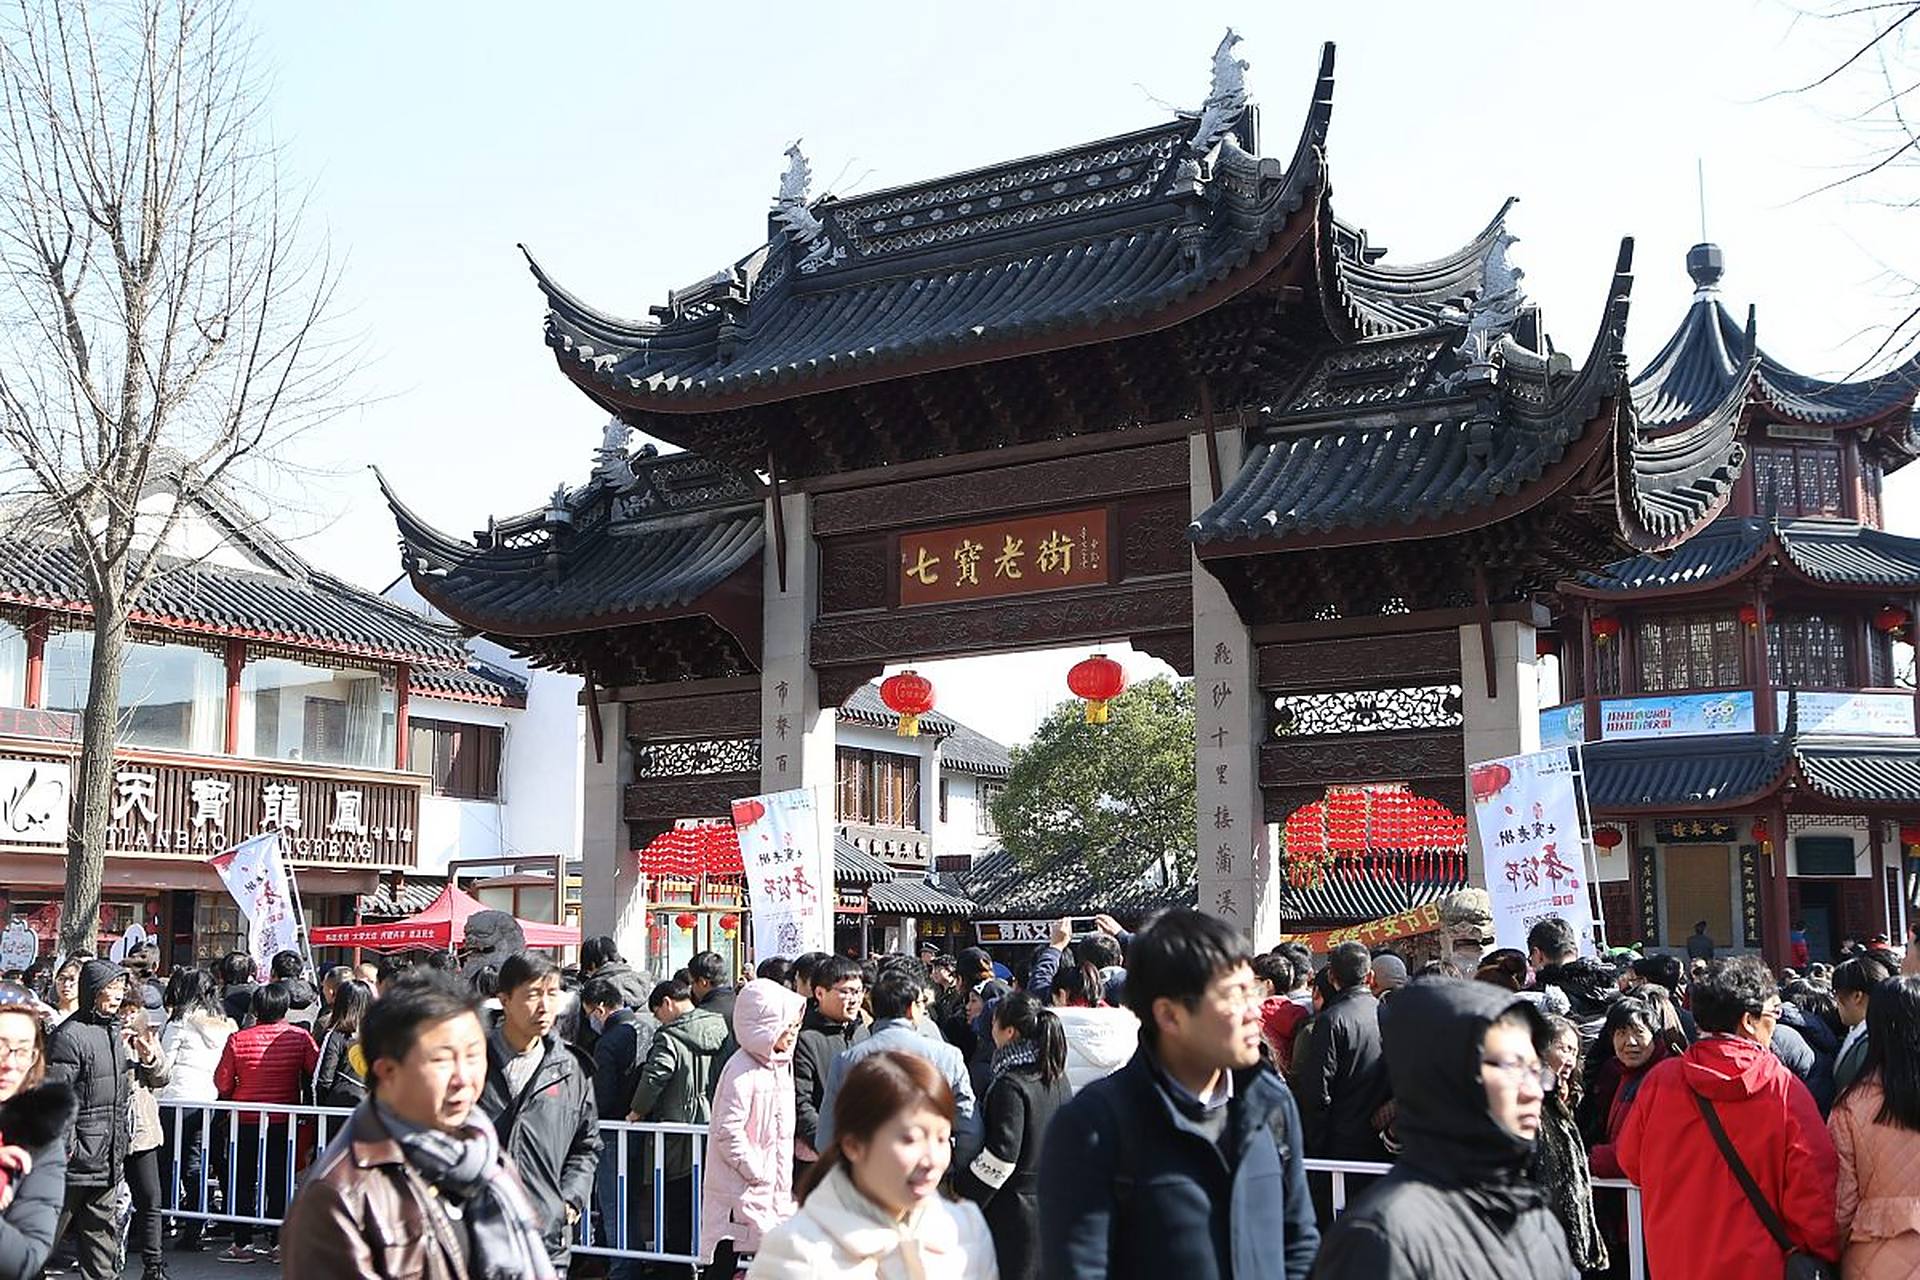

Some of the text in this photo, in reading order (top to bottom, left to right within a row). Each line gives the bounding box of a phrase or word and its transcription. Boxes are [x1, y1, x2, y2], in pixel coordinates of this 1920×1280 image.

[906, 529, 1076, 587] 七寶老街
[112, 771, 368, 837] 天寶龍鳳
[106, 825, 372, 858] TIANBAO NGFENG
